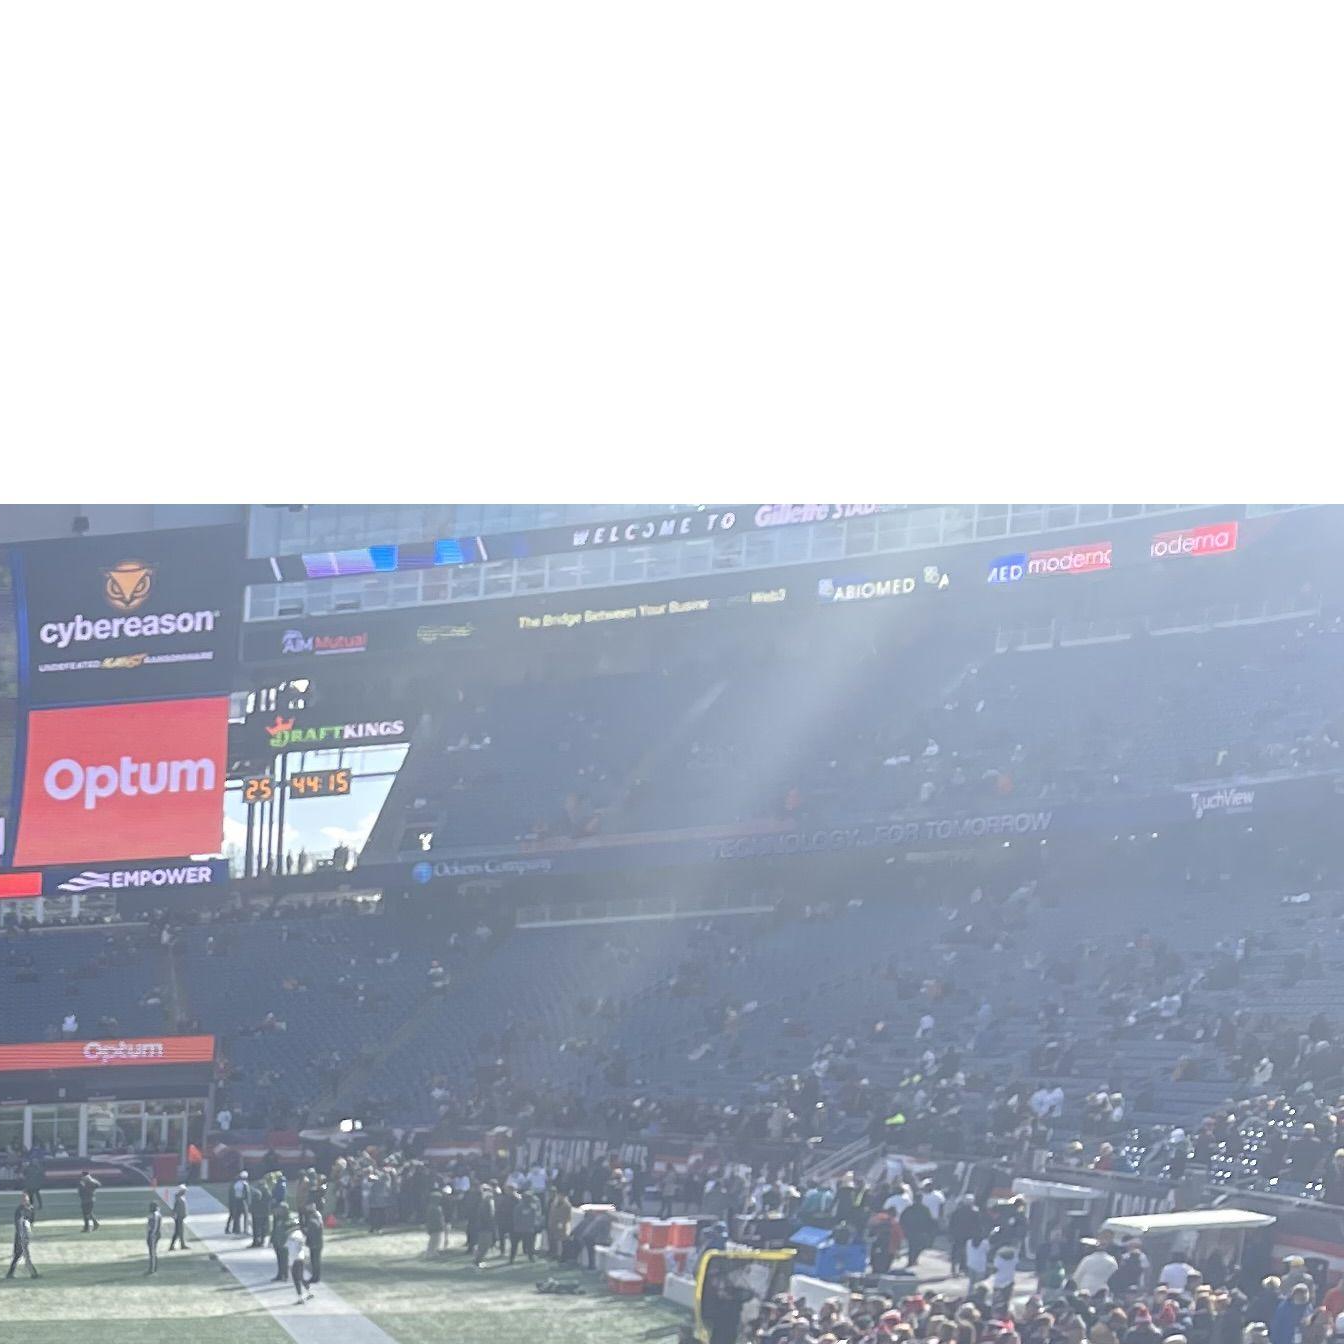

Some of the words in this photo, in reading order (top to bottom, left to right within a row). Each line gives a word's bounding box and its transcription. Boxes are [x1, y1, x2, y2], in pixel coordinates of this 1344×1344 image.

[573, 515, 693, 546] WELCOME
[707, 510, 736, 532] TO
[833, 577, 916, 602] ABIOMED
[584, 608, 637, 623] Between
[668, 599, 711, 614] Busine
[39, 610, 214, 648] cybereason
[268, 719, 406, 748] DRAFTKINGS
[44, 756, 215, 810] Optum
[291, 768, 350, 795] 44:15
[1191, 788, 1255, 812] TuchView
[111, 865, 213, 889] EMPOWER
[81, 1040, 165, 1064] Optum
